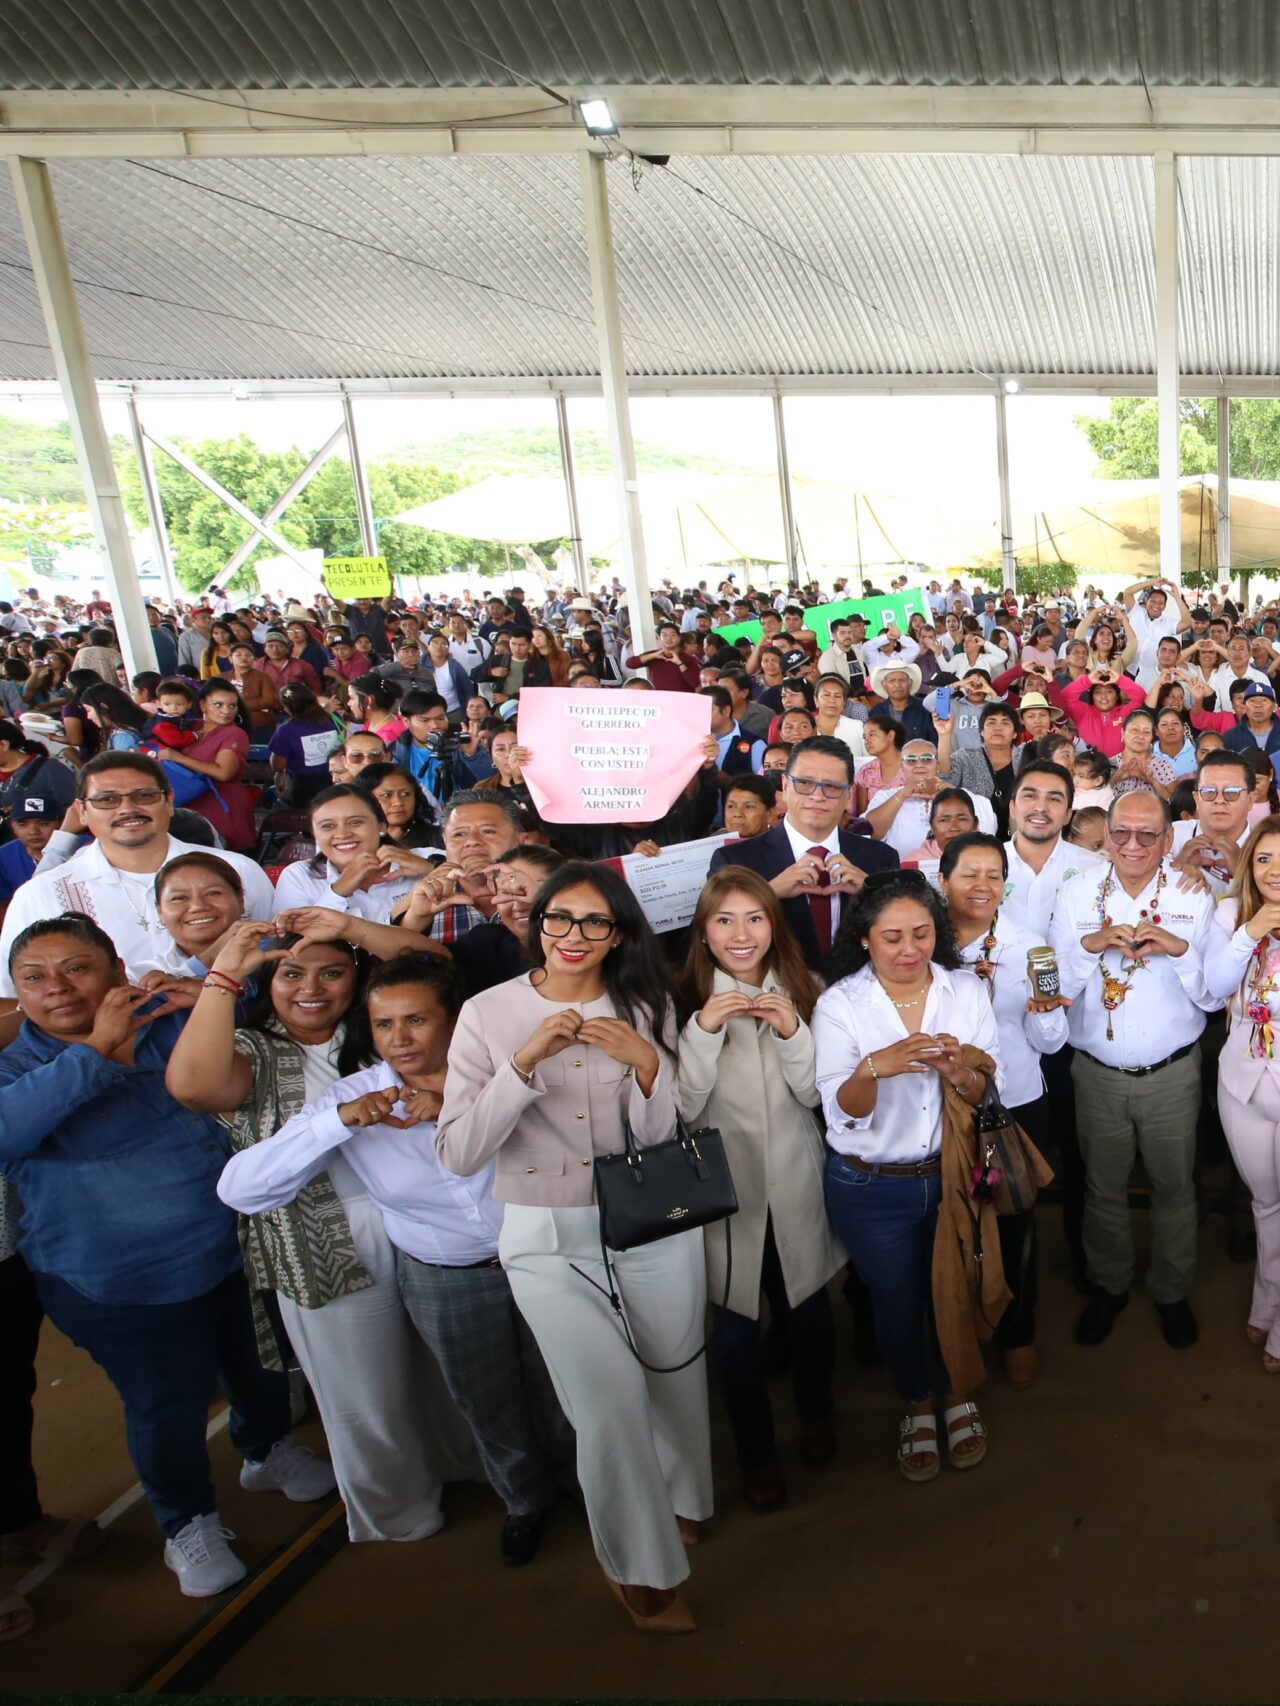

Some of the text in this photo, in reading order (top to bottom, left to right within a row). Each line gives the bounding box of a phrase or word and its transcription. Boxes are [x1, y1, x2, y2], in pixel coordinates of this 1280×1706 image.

[324, 562, 385, 574] TECOLUTLA
[328, 576, 382, 587] PRESENTE
[568, 705, 658, 717] TOTOLTEPEC DE
[574, 745, 649, 756] PUEBLA; ESTA
[580, 759, 644, 769] CON USTED
[579, 787, 647, 797] ALEJANDRO
[584, 800, 641, 809] ARMENTA
